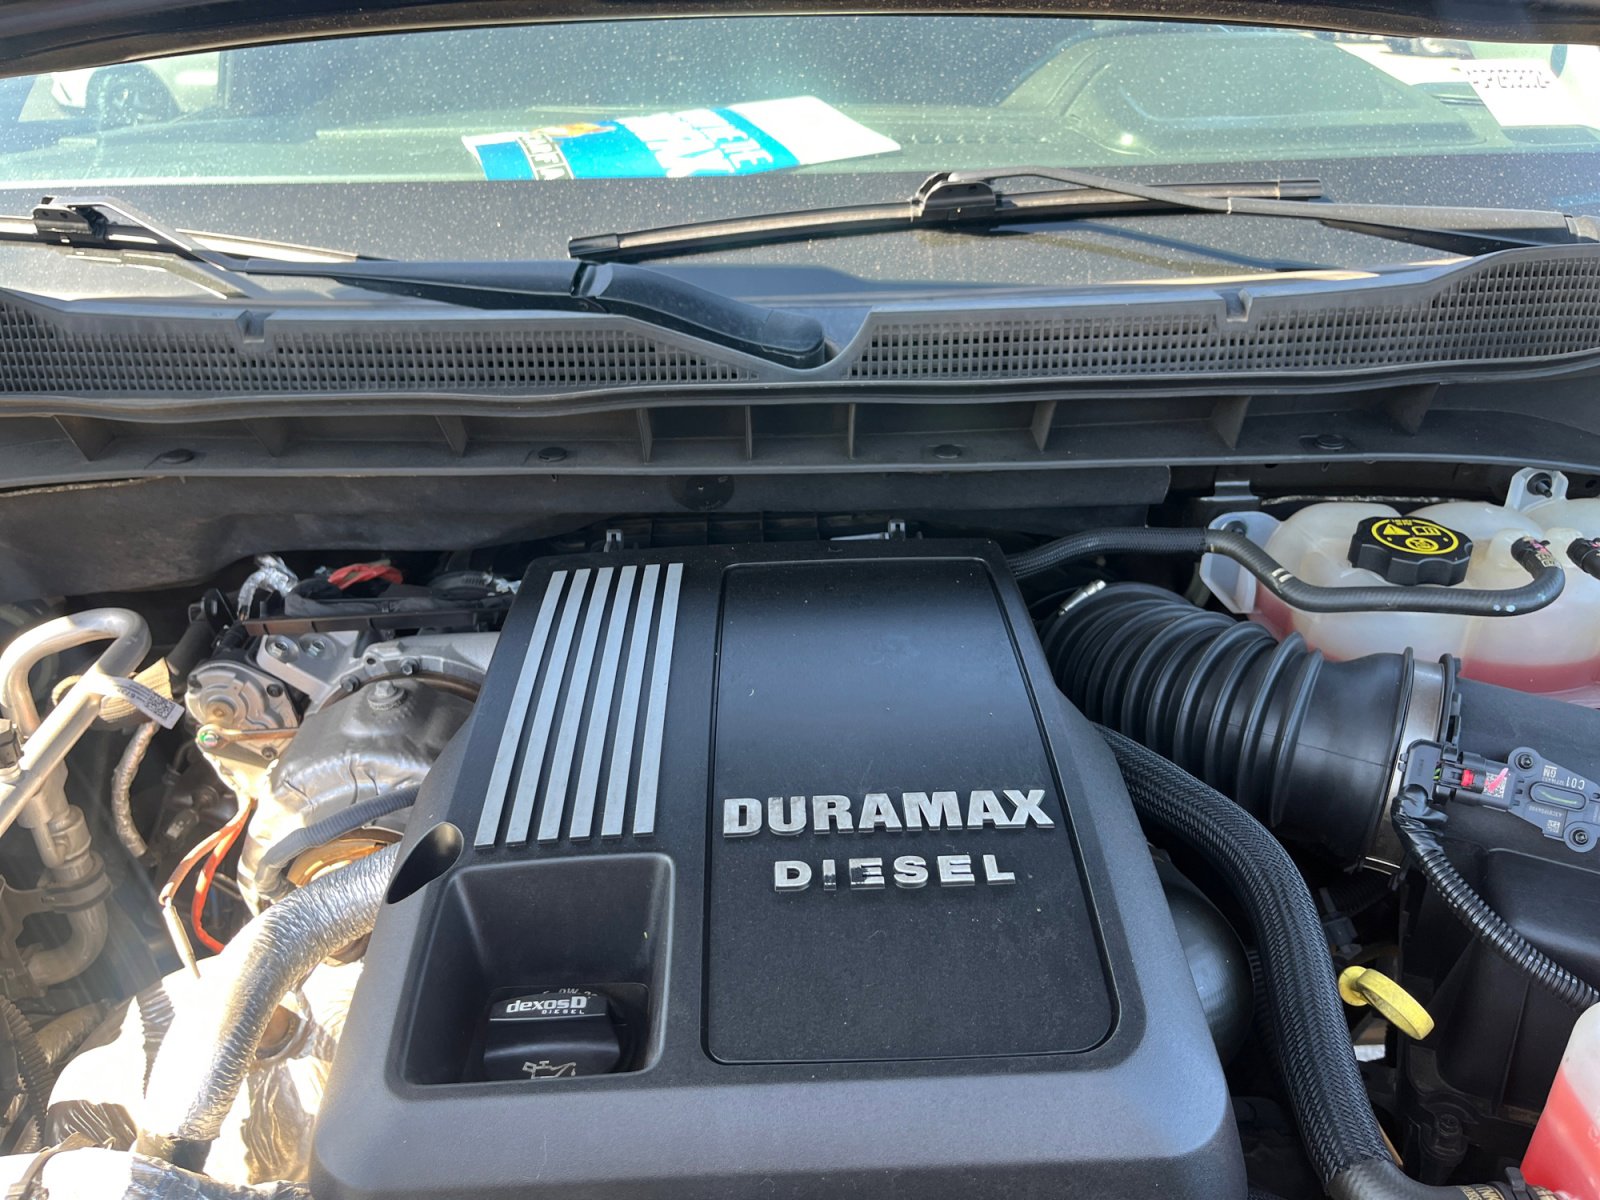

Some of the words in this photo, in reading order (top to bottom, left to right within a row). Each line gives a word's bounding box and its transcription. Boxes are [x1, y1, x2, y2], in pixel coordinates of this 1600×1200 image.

[1565, 776, 1586, 790] C01
[723, 790, 1055, 837] DURAMAX
[774, 855, 1016, 892] DIESEL
[506, 996, 587, 1013] dexosD
